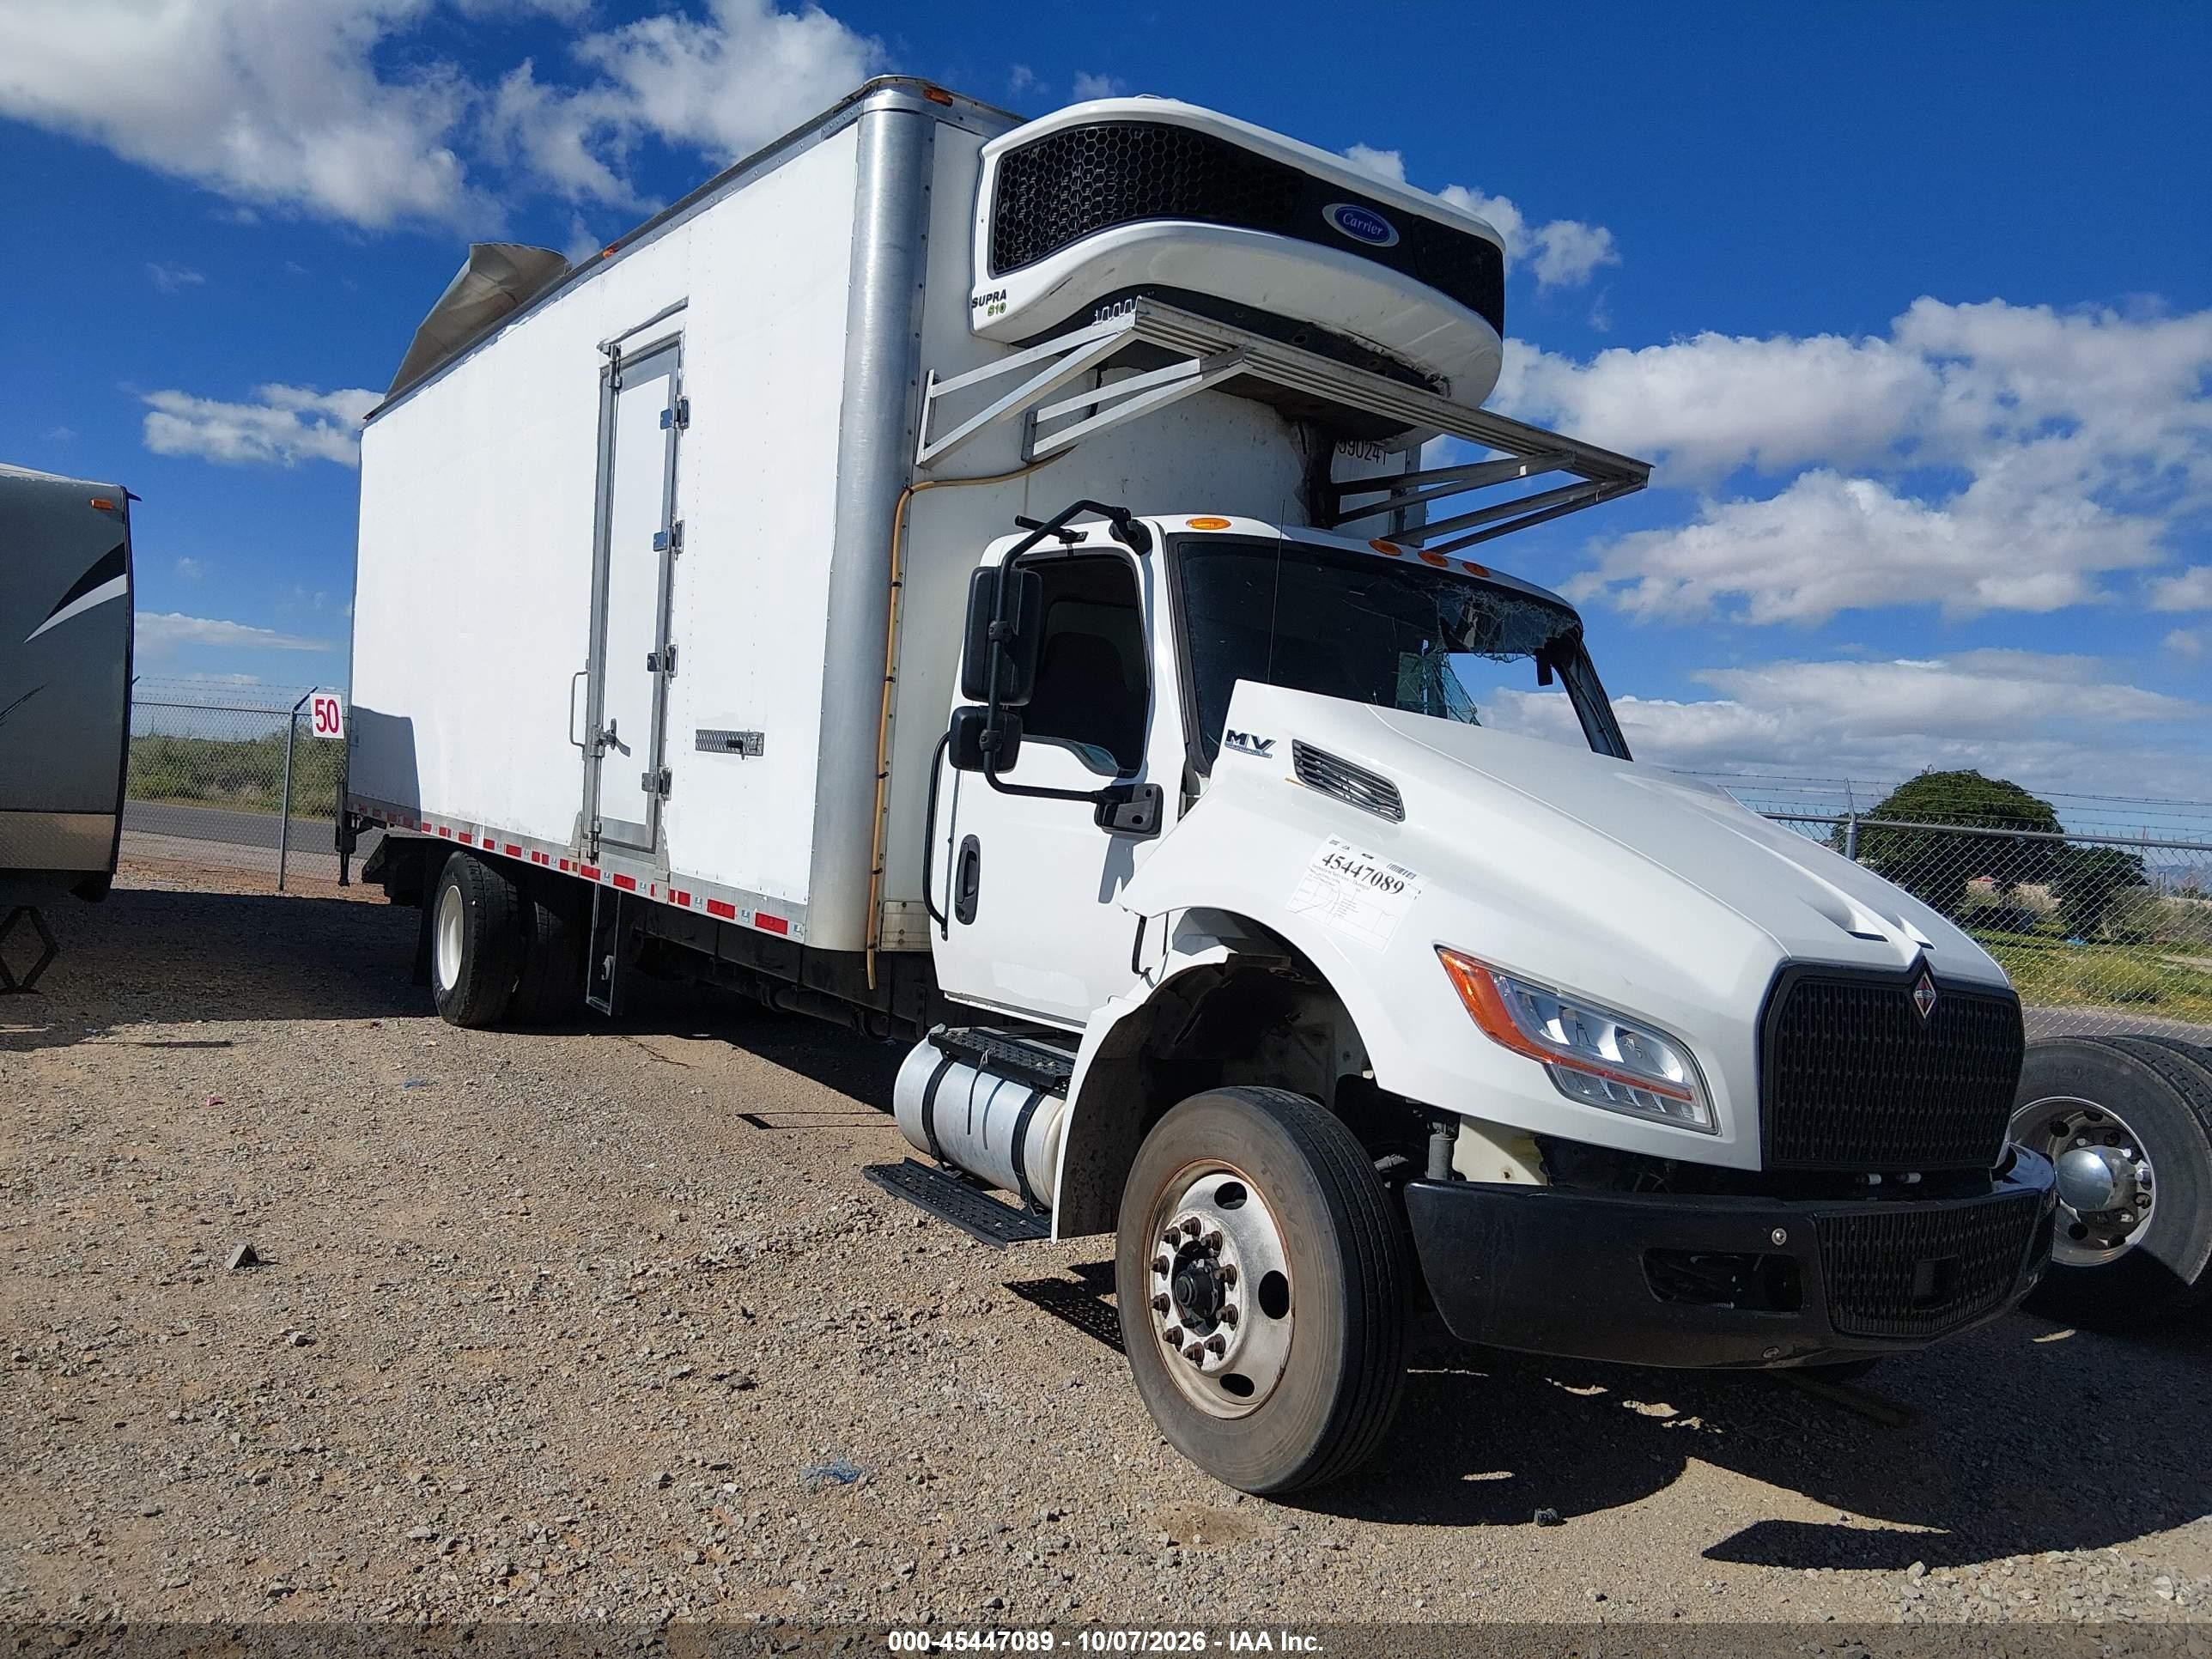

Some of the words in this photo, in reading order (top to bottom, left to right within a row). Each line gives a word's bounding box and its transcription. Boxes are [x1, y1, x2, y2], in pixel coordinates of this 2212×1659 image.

[1343, 213, 1383, 236] Carrier
[971, 289, 1006, 309] SUPRA
[315, 699, 339, 733] 50
[1226, 729, 1276, 752] MV
[1322, 853, 1405, 895] 45447089
